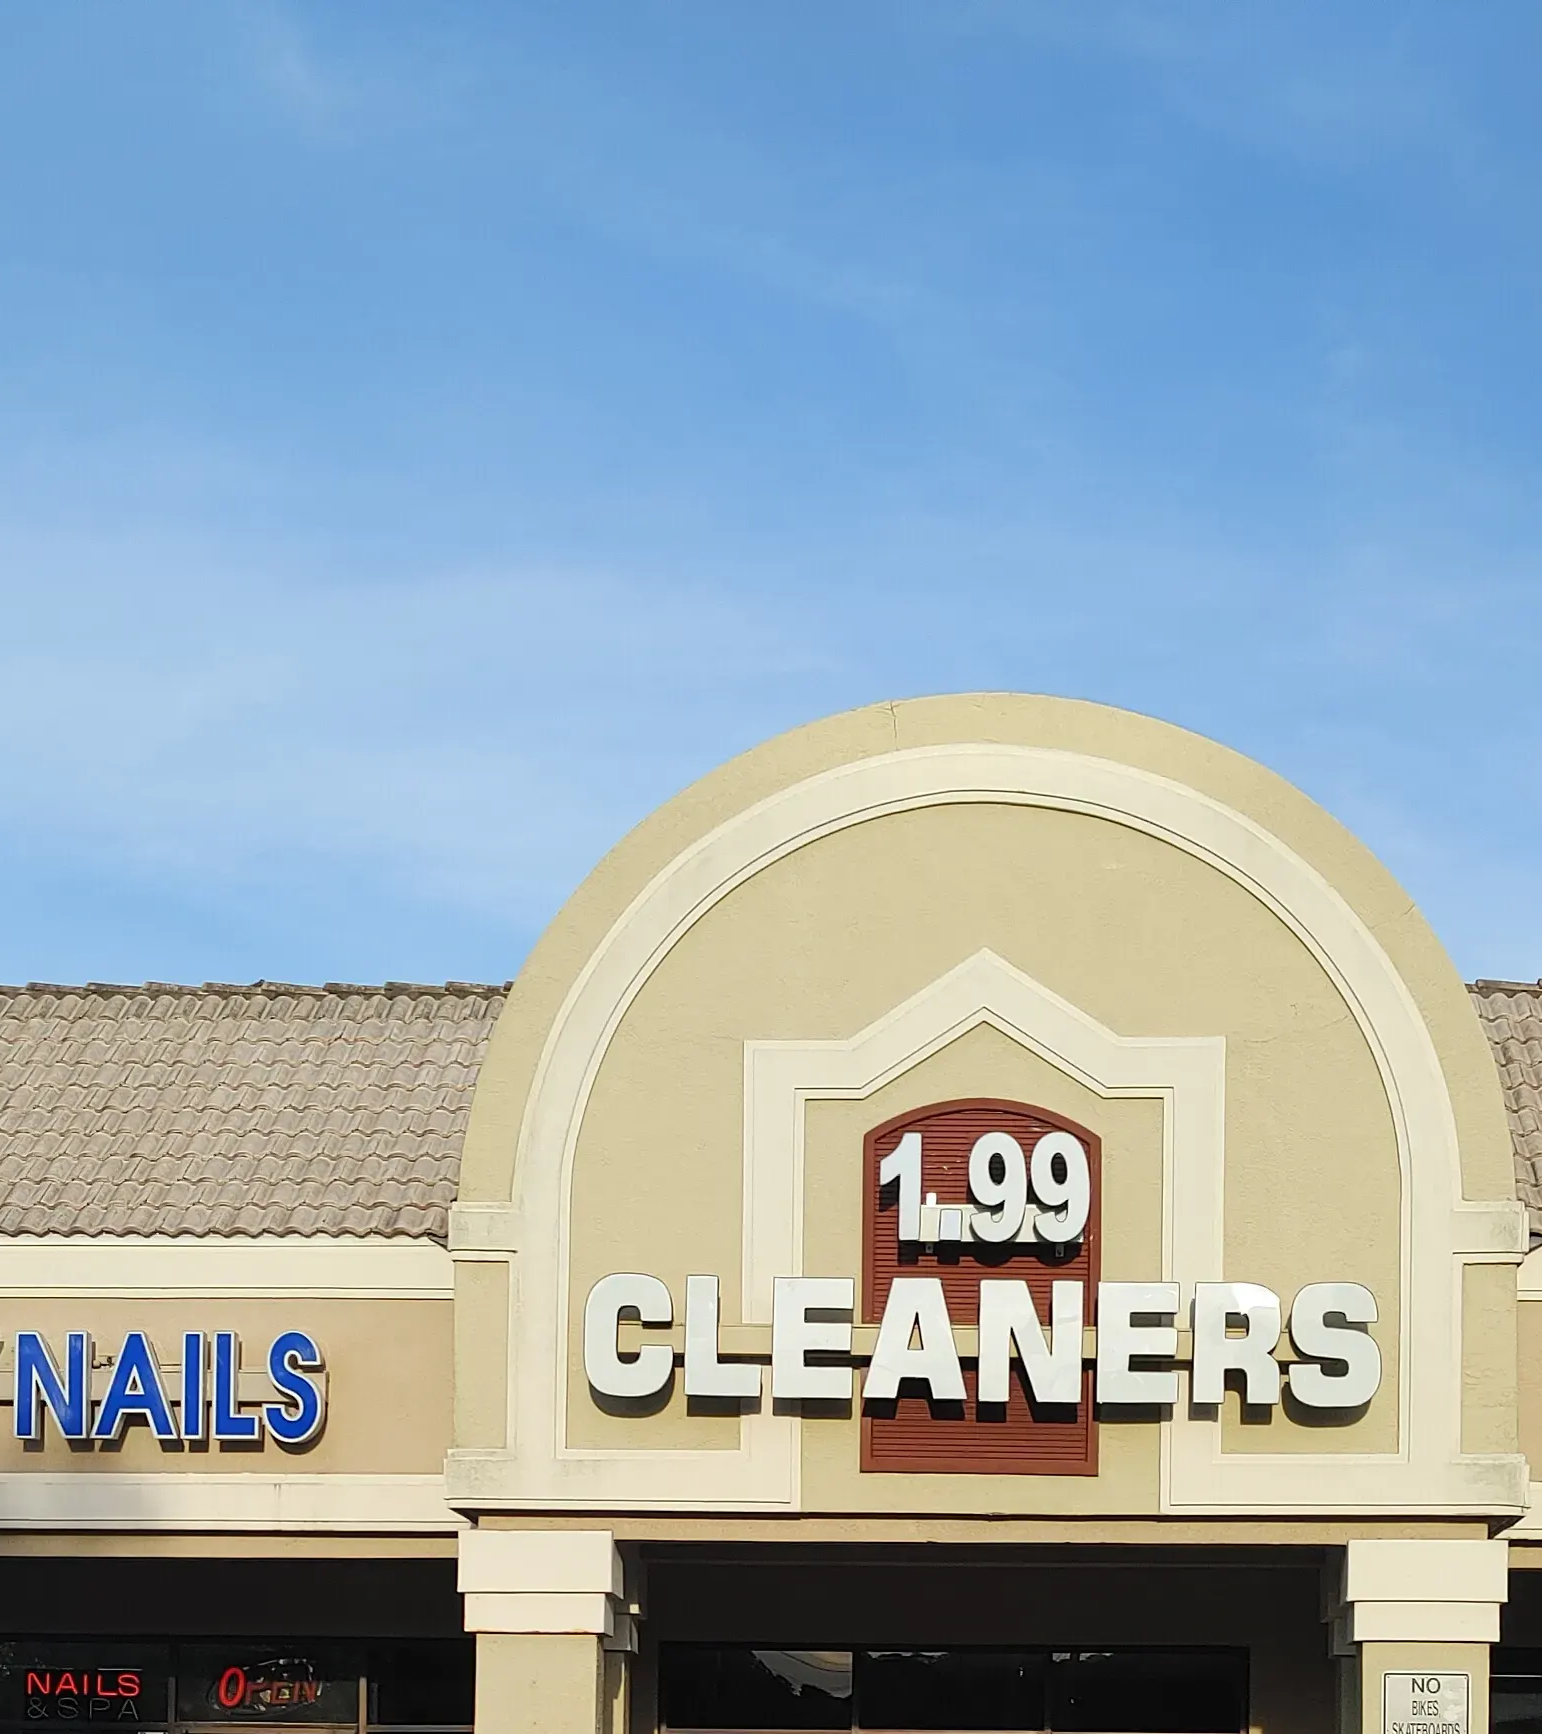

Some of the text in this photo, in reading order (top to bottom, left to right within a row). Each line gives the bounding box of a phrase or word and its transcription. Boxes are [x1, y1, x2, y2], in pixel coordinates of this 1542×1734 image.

[879, 1131, 1091, 1243] 1.99
[583, 1271, 1382, 1409] CLEANERS
[14, 1330, 324, 1443] NAILS
[27, 1673, 141, 1697] NAILS
[27, 1697, 139, 1720] & SPA
[1411, 1678, 1441, 1693] NO
